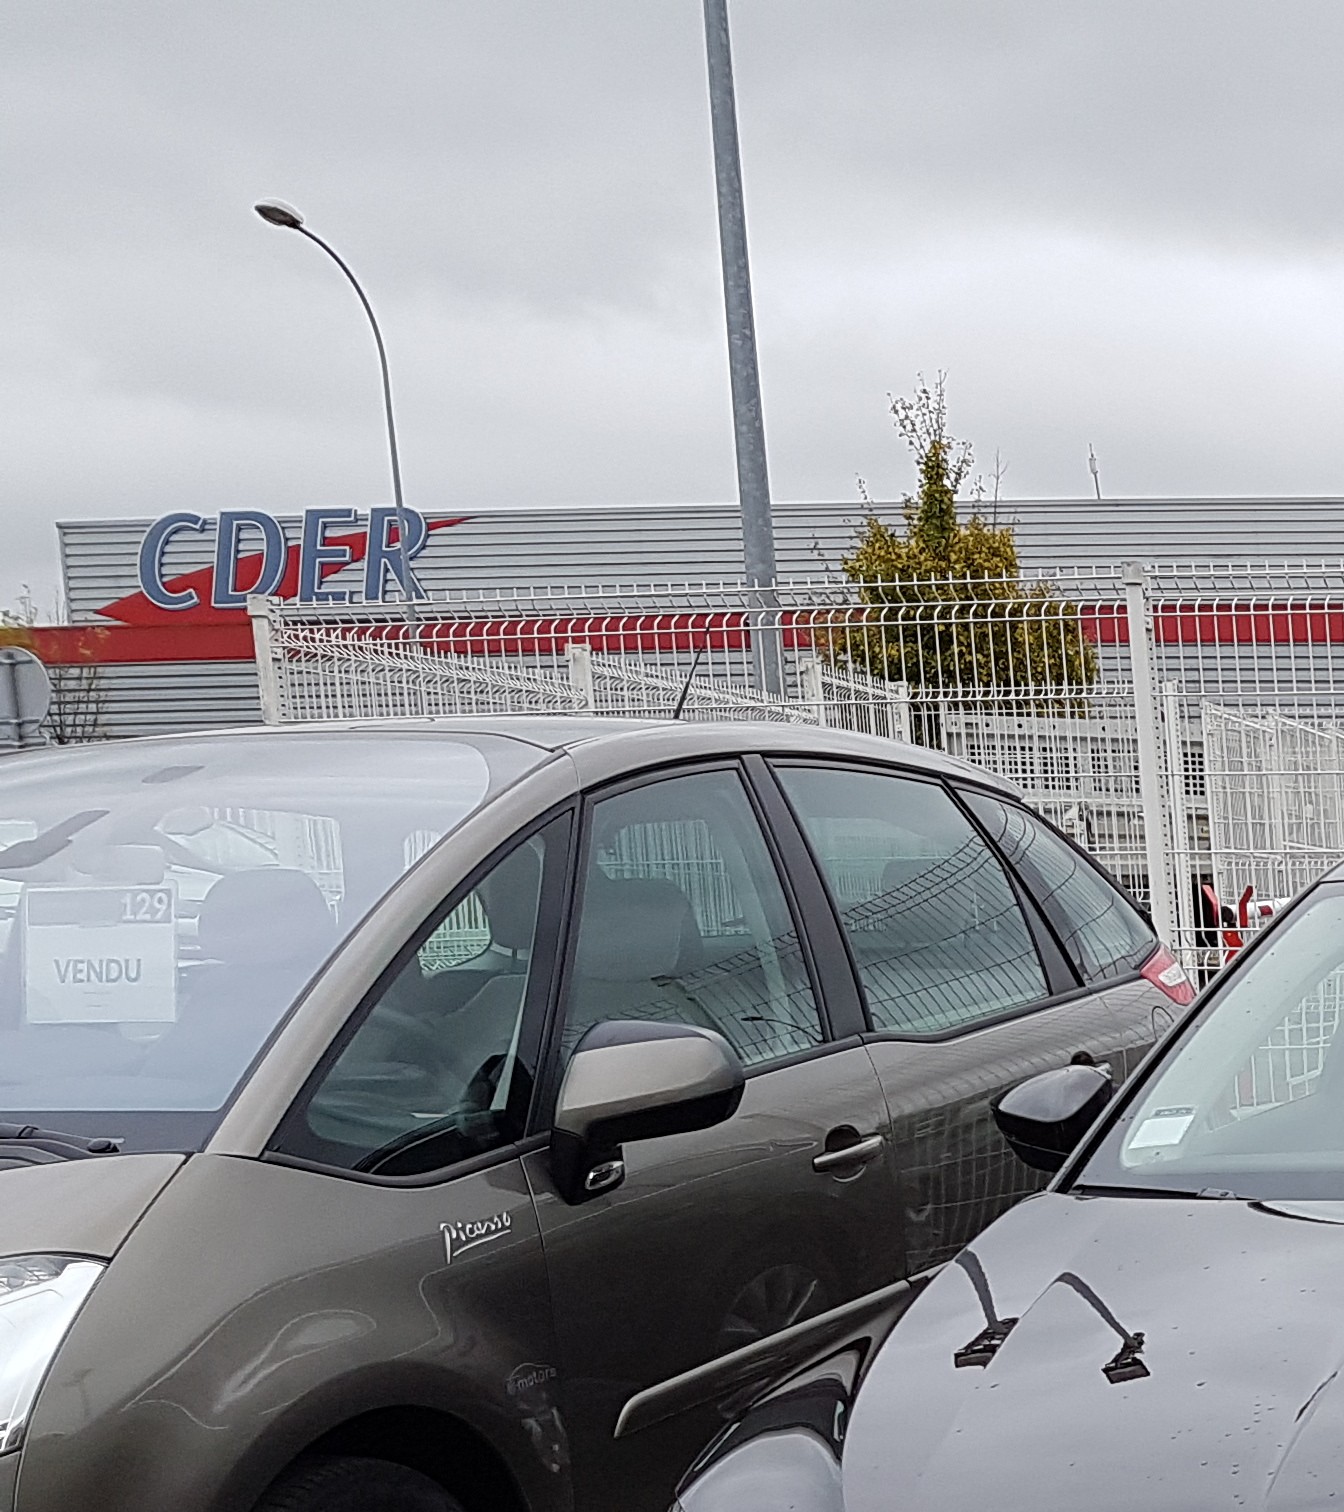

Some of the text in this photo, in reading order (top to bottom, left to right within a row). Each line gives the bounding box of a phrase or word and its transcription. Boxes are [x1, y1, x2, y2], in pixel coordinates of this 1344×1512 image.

[137, 505, 429, 611] CDER
[120, 892, 169, 921] 129
[53, 957, 142, 984] VENDU
[440, 1211, 512, 1264] Picasso
